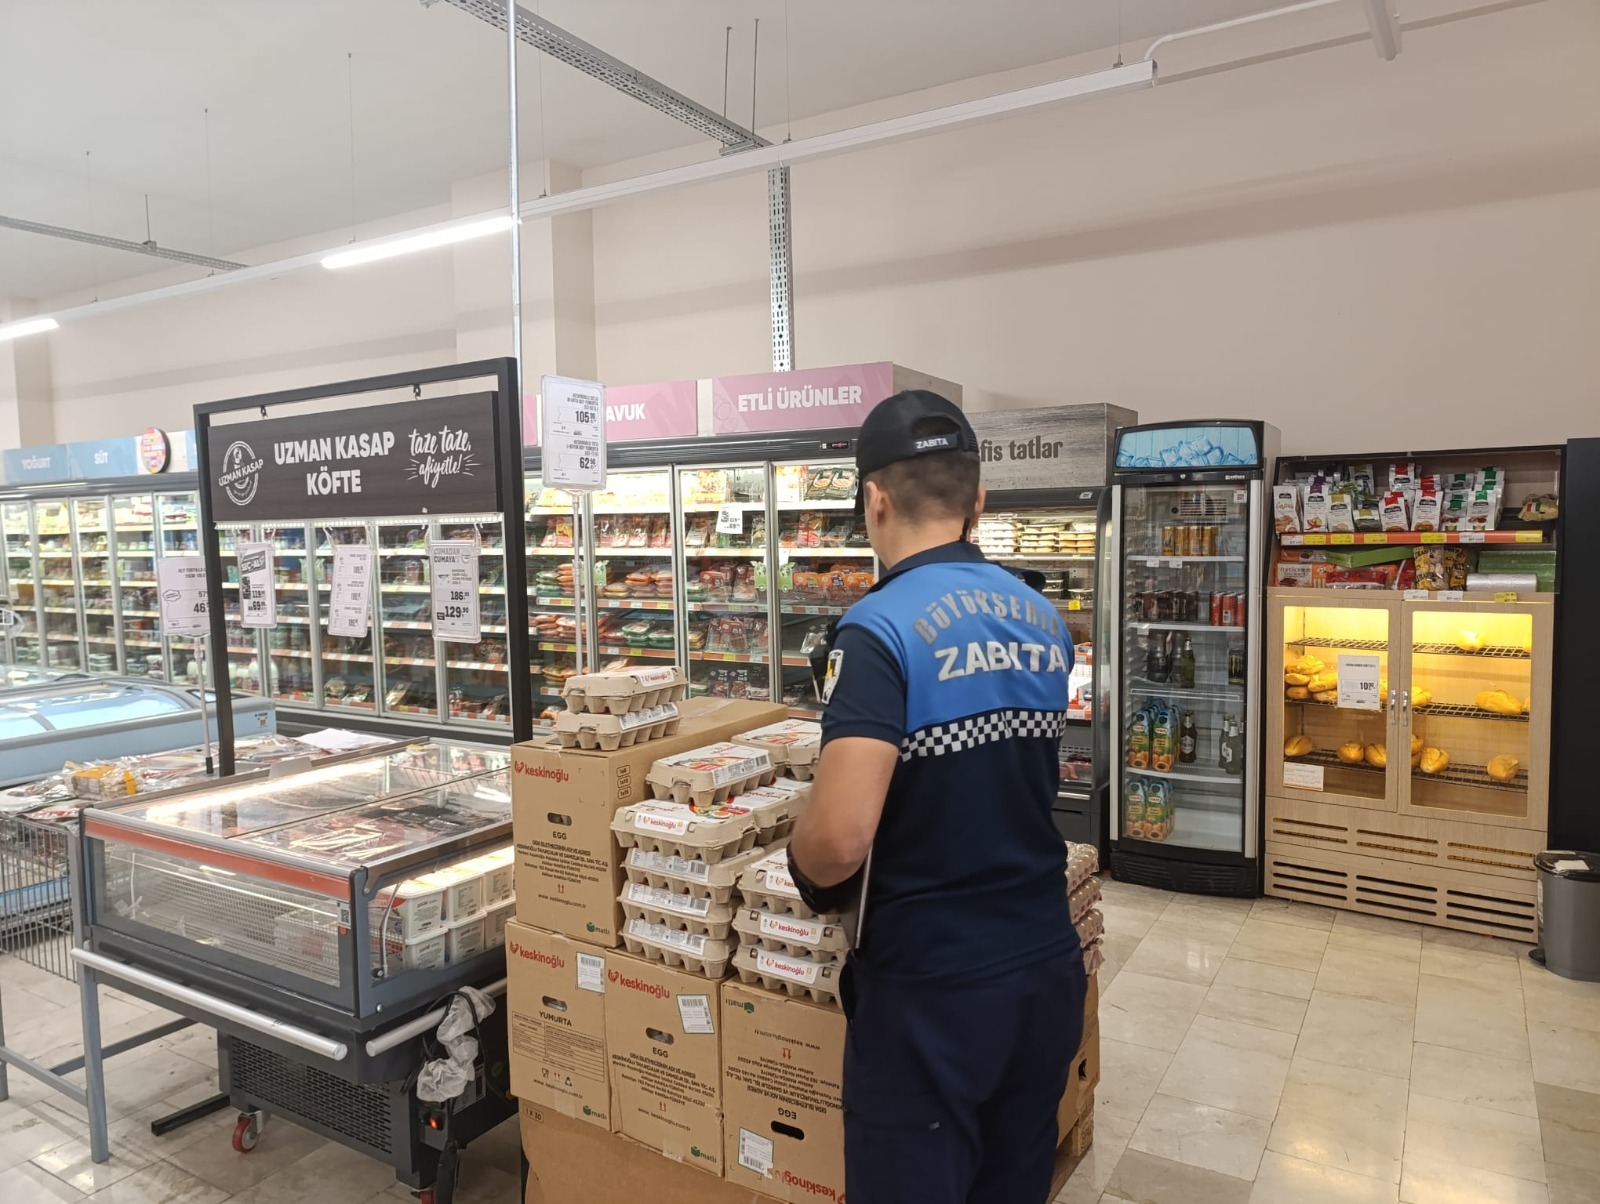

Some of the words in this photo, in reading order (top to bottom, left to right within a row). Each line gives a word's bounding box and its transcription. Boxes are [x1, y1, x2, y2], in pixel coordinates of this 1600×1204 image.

[738, 388, 773, 412] ETLİ
[779, 385, 862, 409] ÜRÜNLER
[575, 411, 589, 423] 105
[605, 403, 646, 422] AVUK
[274, 437, 331, 465] UZMAN
[335, 431, 395, 459] KASAP
[408, 428, 438, 456] taze
[915, 437, 949, 449] ZABITA
[980, 438, 1003, 462] fis
[1009, 435, 1063, 460] tatlar
[94, 450, 109, 464] SÜT
[579, 457, 590, 469] 62
[218, 468, 242, 487] UZMAN
[241, 459, 264, 476] KASAP
[419, 454, 461, 488] afiyetle!
[306, 466, 362, 495] KÖFTE
[193, 602, 206, 614] 46
[934, 640, 1068, 682] ZABITA
[524, 764, 569, 783] keskinoğlu
[552, 831, 567, 840] EGG
[778, 923, 809, 937] keskinoğlu
[520, 946, 565, 969] keskinoğlu
[774, 961, 805, 976] keskinoğlu
[620, 974, 670, 999] keskinoğlu
[725, 998, 744, 1009] matlı
[539, 1010, 573, 1027] YUMURTA
[652, 1047, 669, 1058] EGG
[782, 1087, 788, 1095] VE
[777, 1107, 797, 1120] EGG
